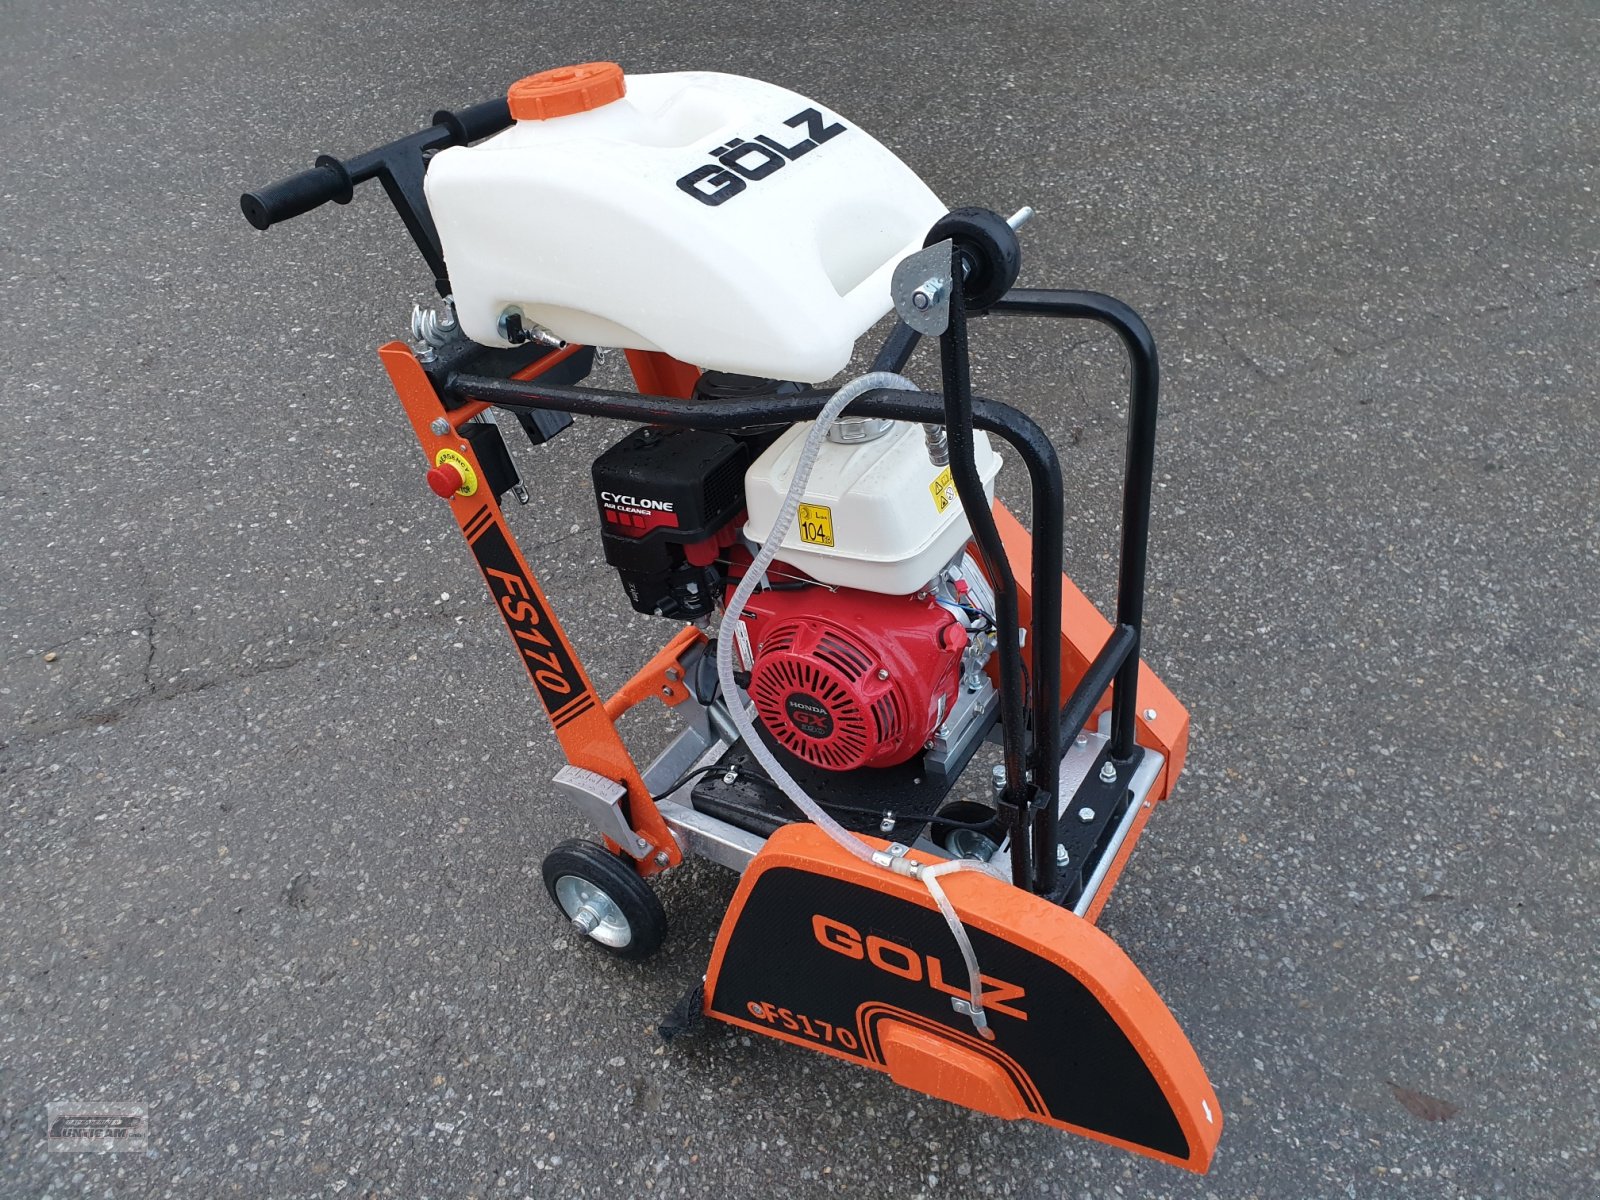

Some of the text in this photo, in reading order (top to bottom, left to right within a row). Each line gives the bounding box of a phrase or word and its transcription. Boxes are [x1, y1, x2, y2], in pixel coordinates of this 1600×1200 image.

[676, 107, 848, 207] GÖLZ
[600, 491, 674, 512] CYCLONE
[604, 502, 652, 516] AIR CLEANER
[802, 521, 825, 543] 104
[486, 567, 572, 695] FS170
[789, 701, 828, 715] HONDA
[793, 710, 828, 728] GX
